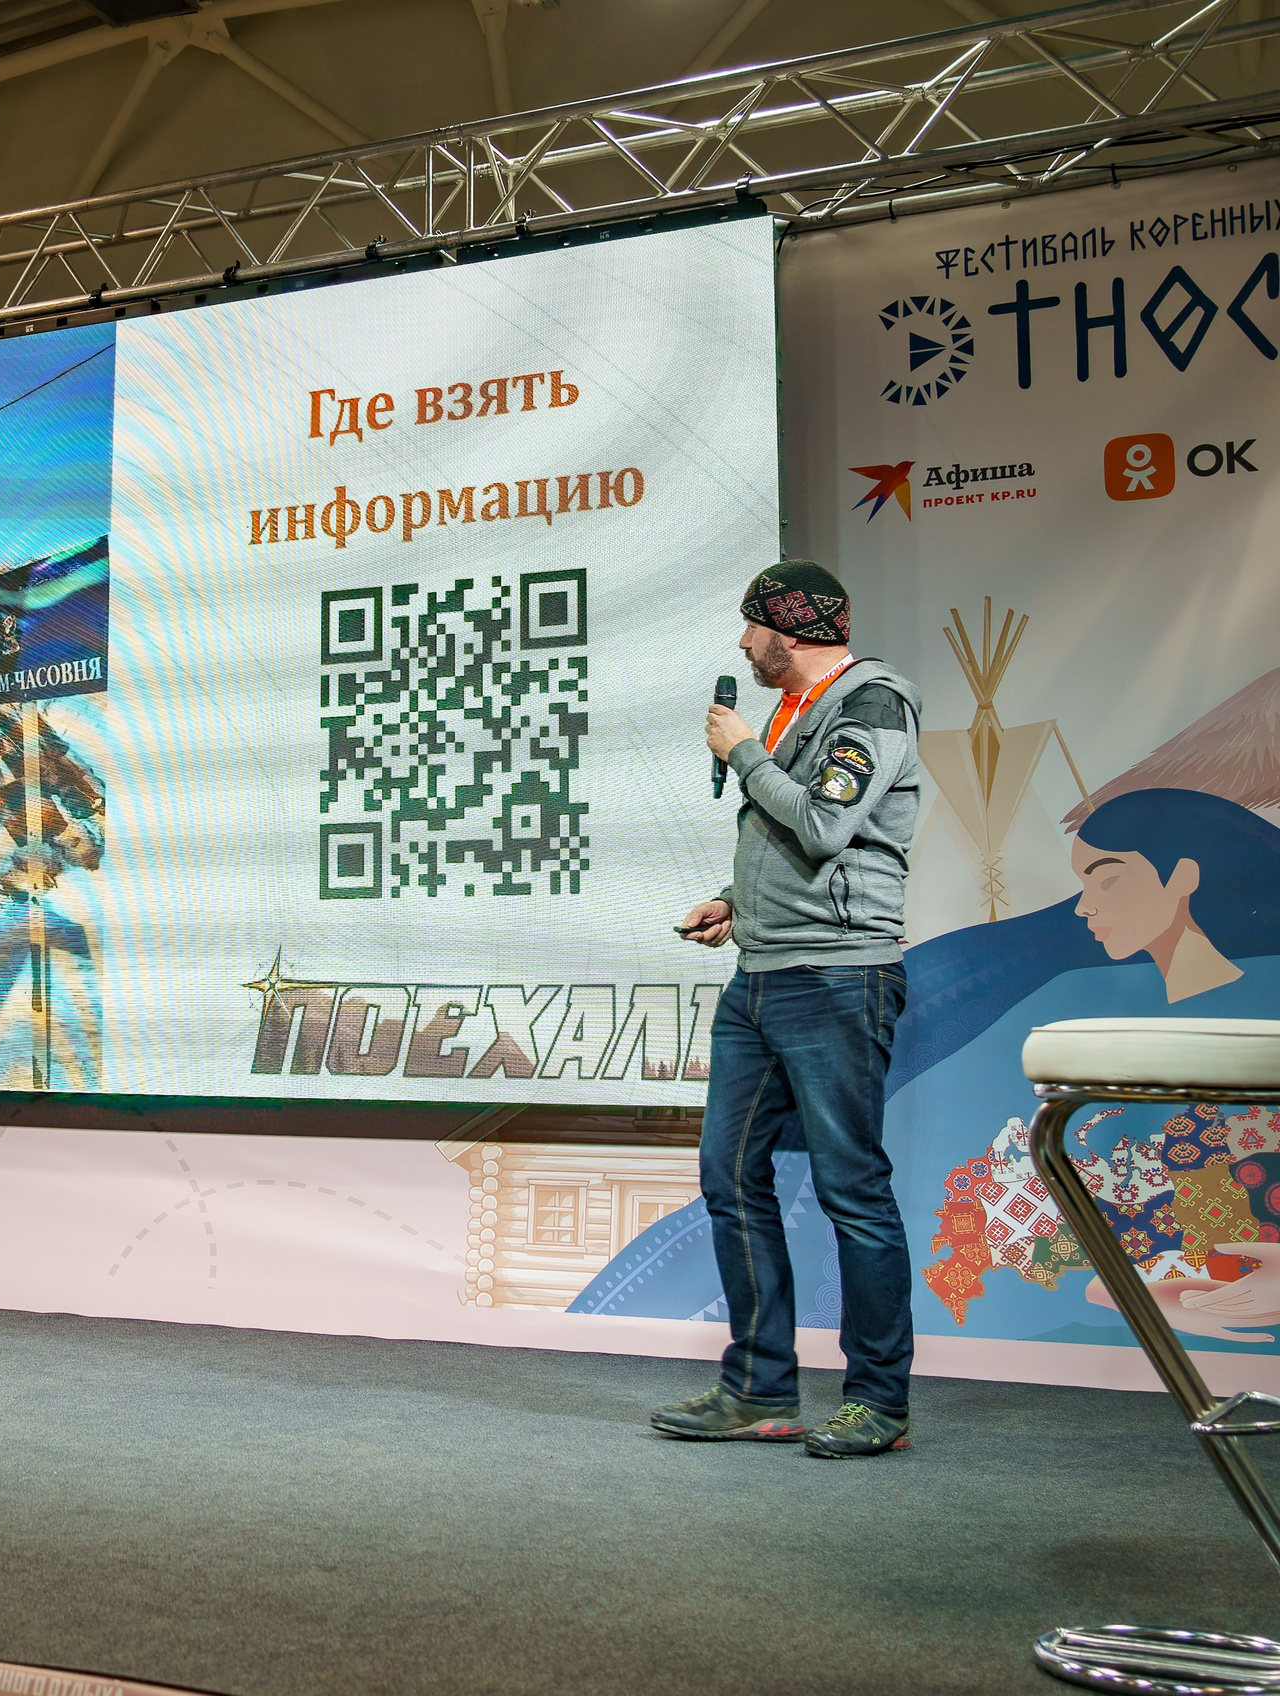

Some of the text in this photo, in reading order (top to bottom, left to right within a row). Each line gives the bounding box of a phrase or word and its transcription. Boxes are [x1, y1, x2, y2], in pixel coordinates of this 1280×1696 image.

[935, 226, 1115, 280] ФЕСТИВАЛЬ
[307, 369, 580, 446] Где взять
[923, 461, 1036, 490] Афиша
[923, 494, 985, 509] ПРОЕКТ
[248, 467, 645, 549] информацию
